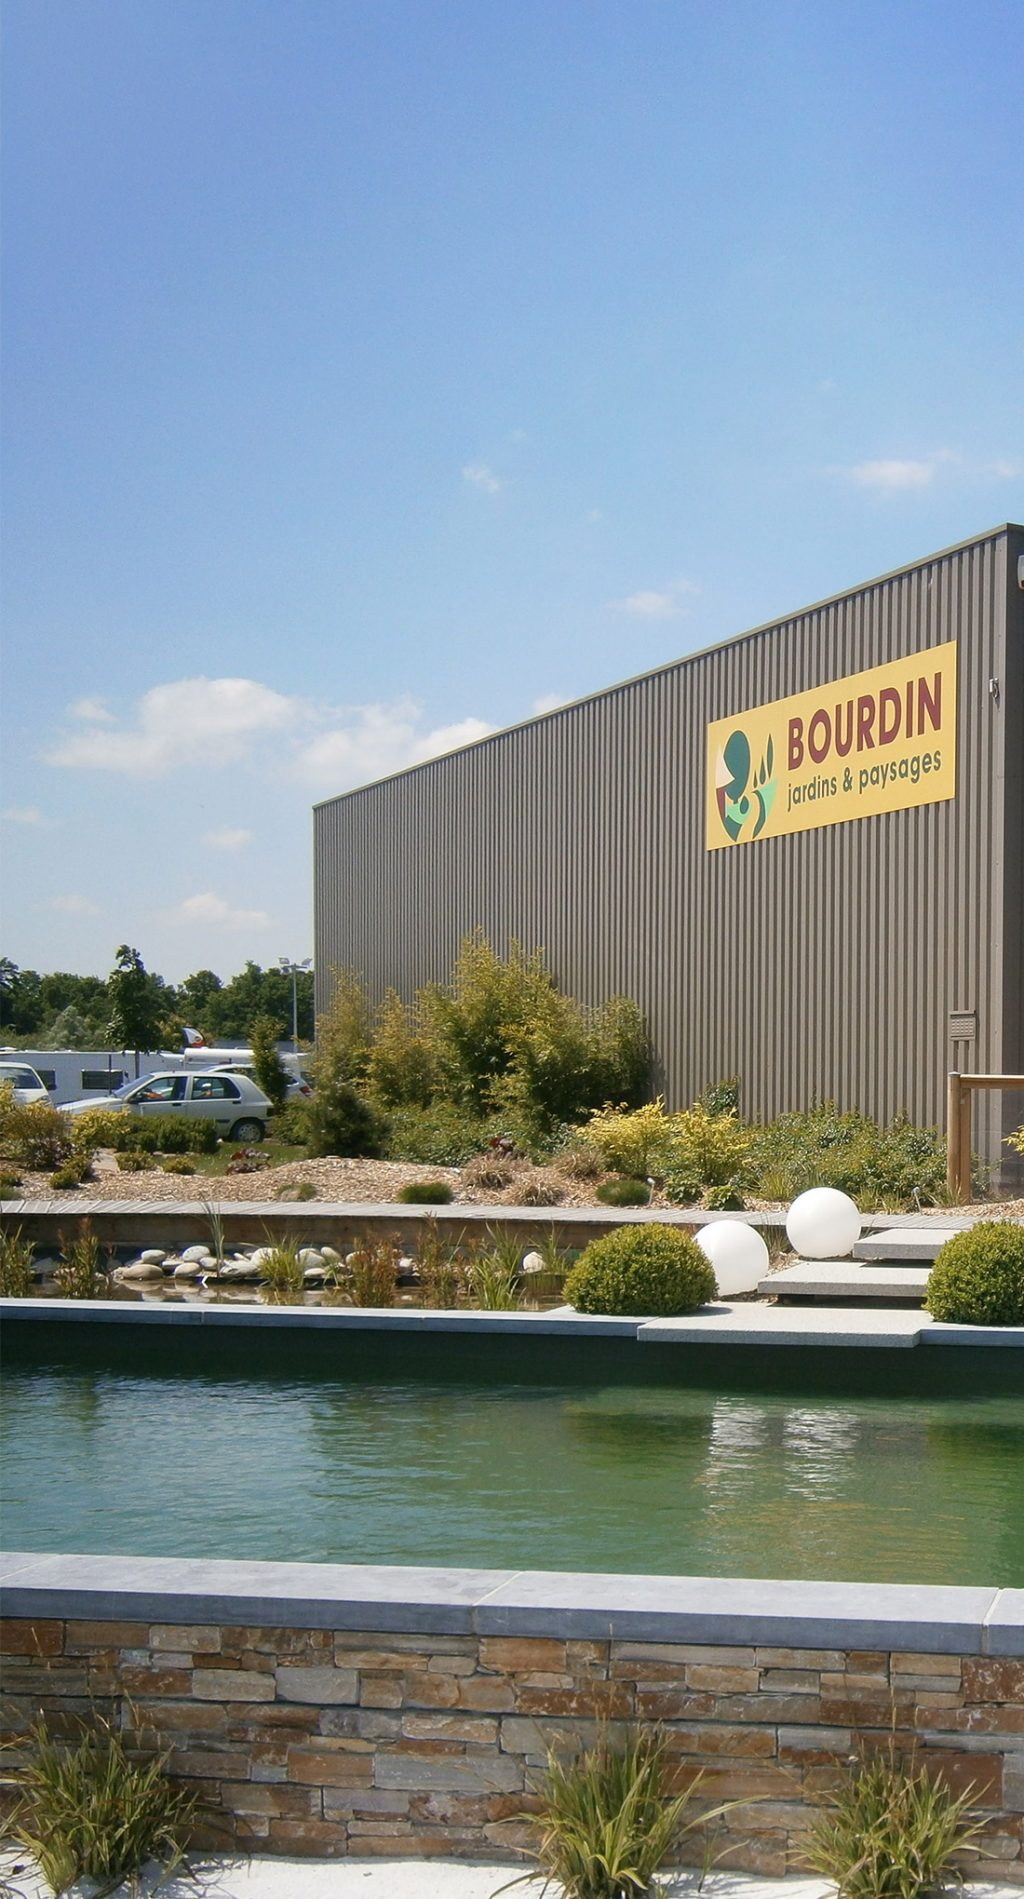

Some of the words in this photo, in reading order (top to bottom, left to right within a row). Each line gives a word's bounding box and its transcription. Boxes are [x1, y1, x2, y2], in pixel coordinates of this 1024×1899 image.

[788, 671, 942, 771] BOURDIN
[787, 775, 837, 812] jardins
[842, 767, 853, 792] &
[858, 750, 942, 794] paysages
